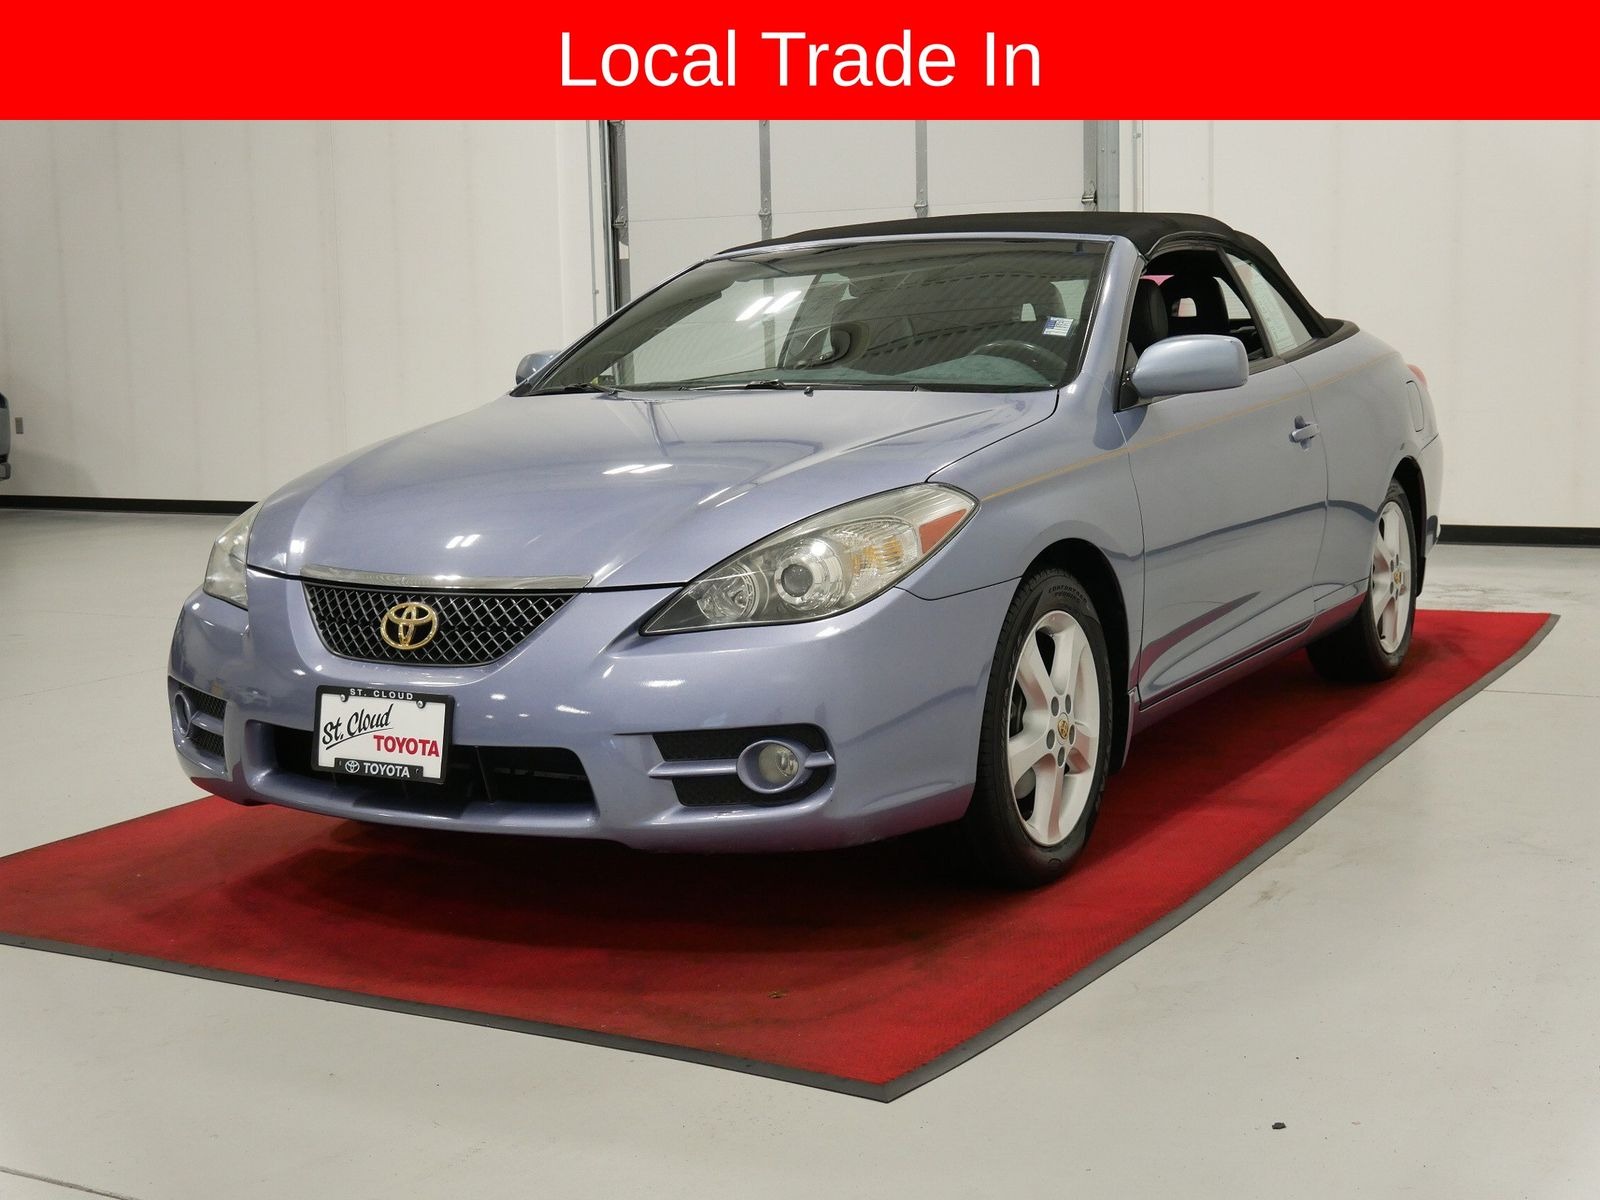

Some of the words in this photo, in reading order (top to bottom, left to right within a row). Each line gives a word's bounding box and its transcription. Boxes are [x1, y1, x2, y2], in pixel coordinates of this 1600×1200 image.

[350, 688, 367, 697] ST.
[373, 690, 414, 700] CLOUD
[322, 716, 344, 745] St.
[347, 703, 394, 737] Cloud
[373, 734, 440, 757] TOYOTA
[363, 762, 410, 778] TOYOTA
